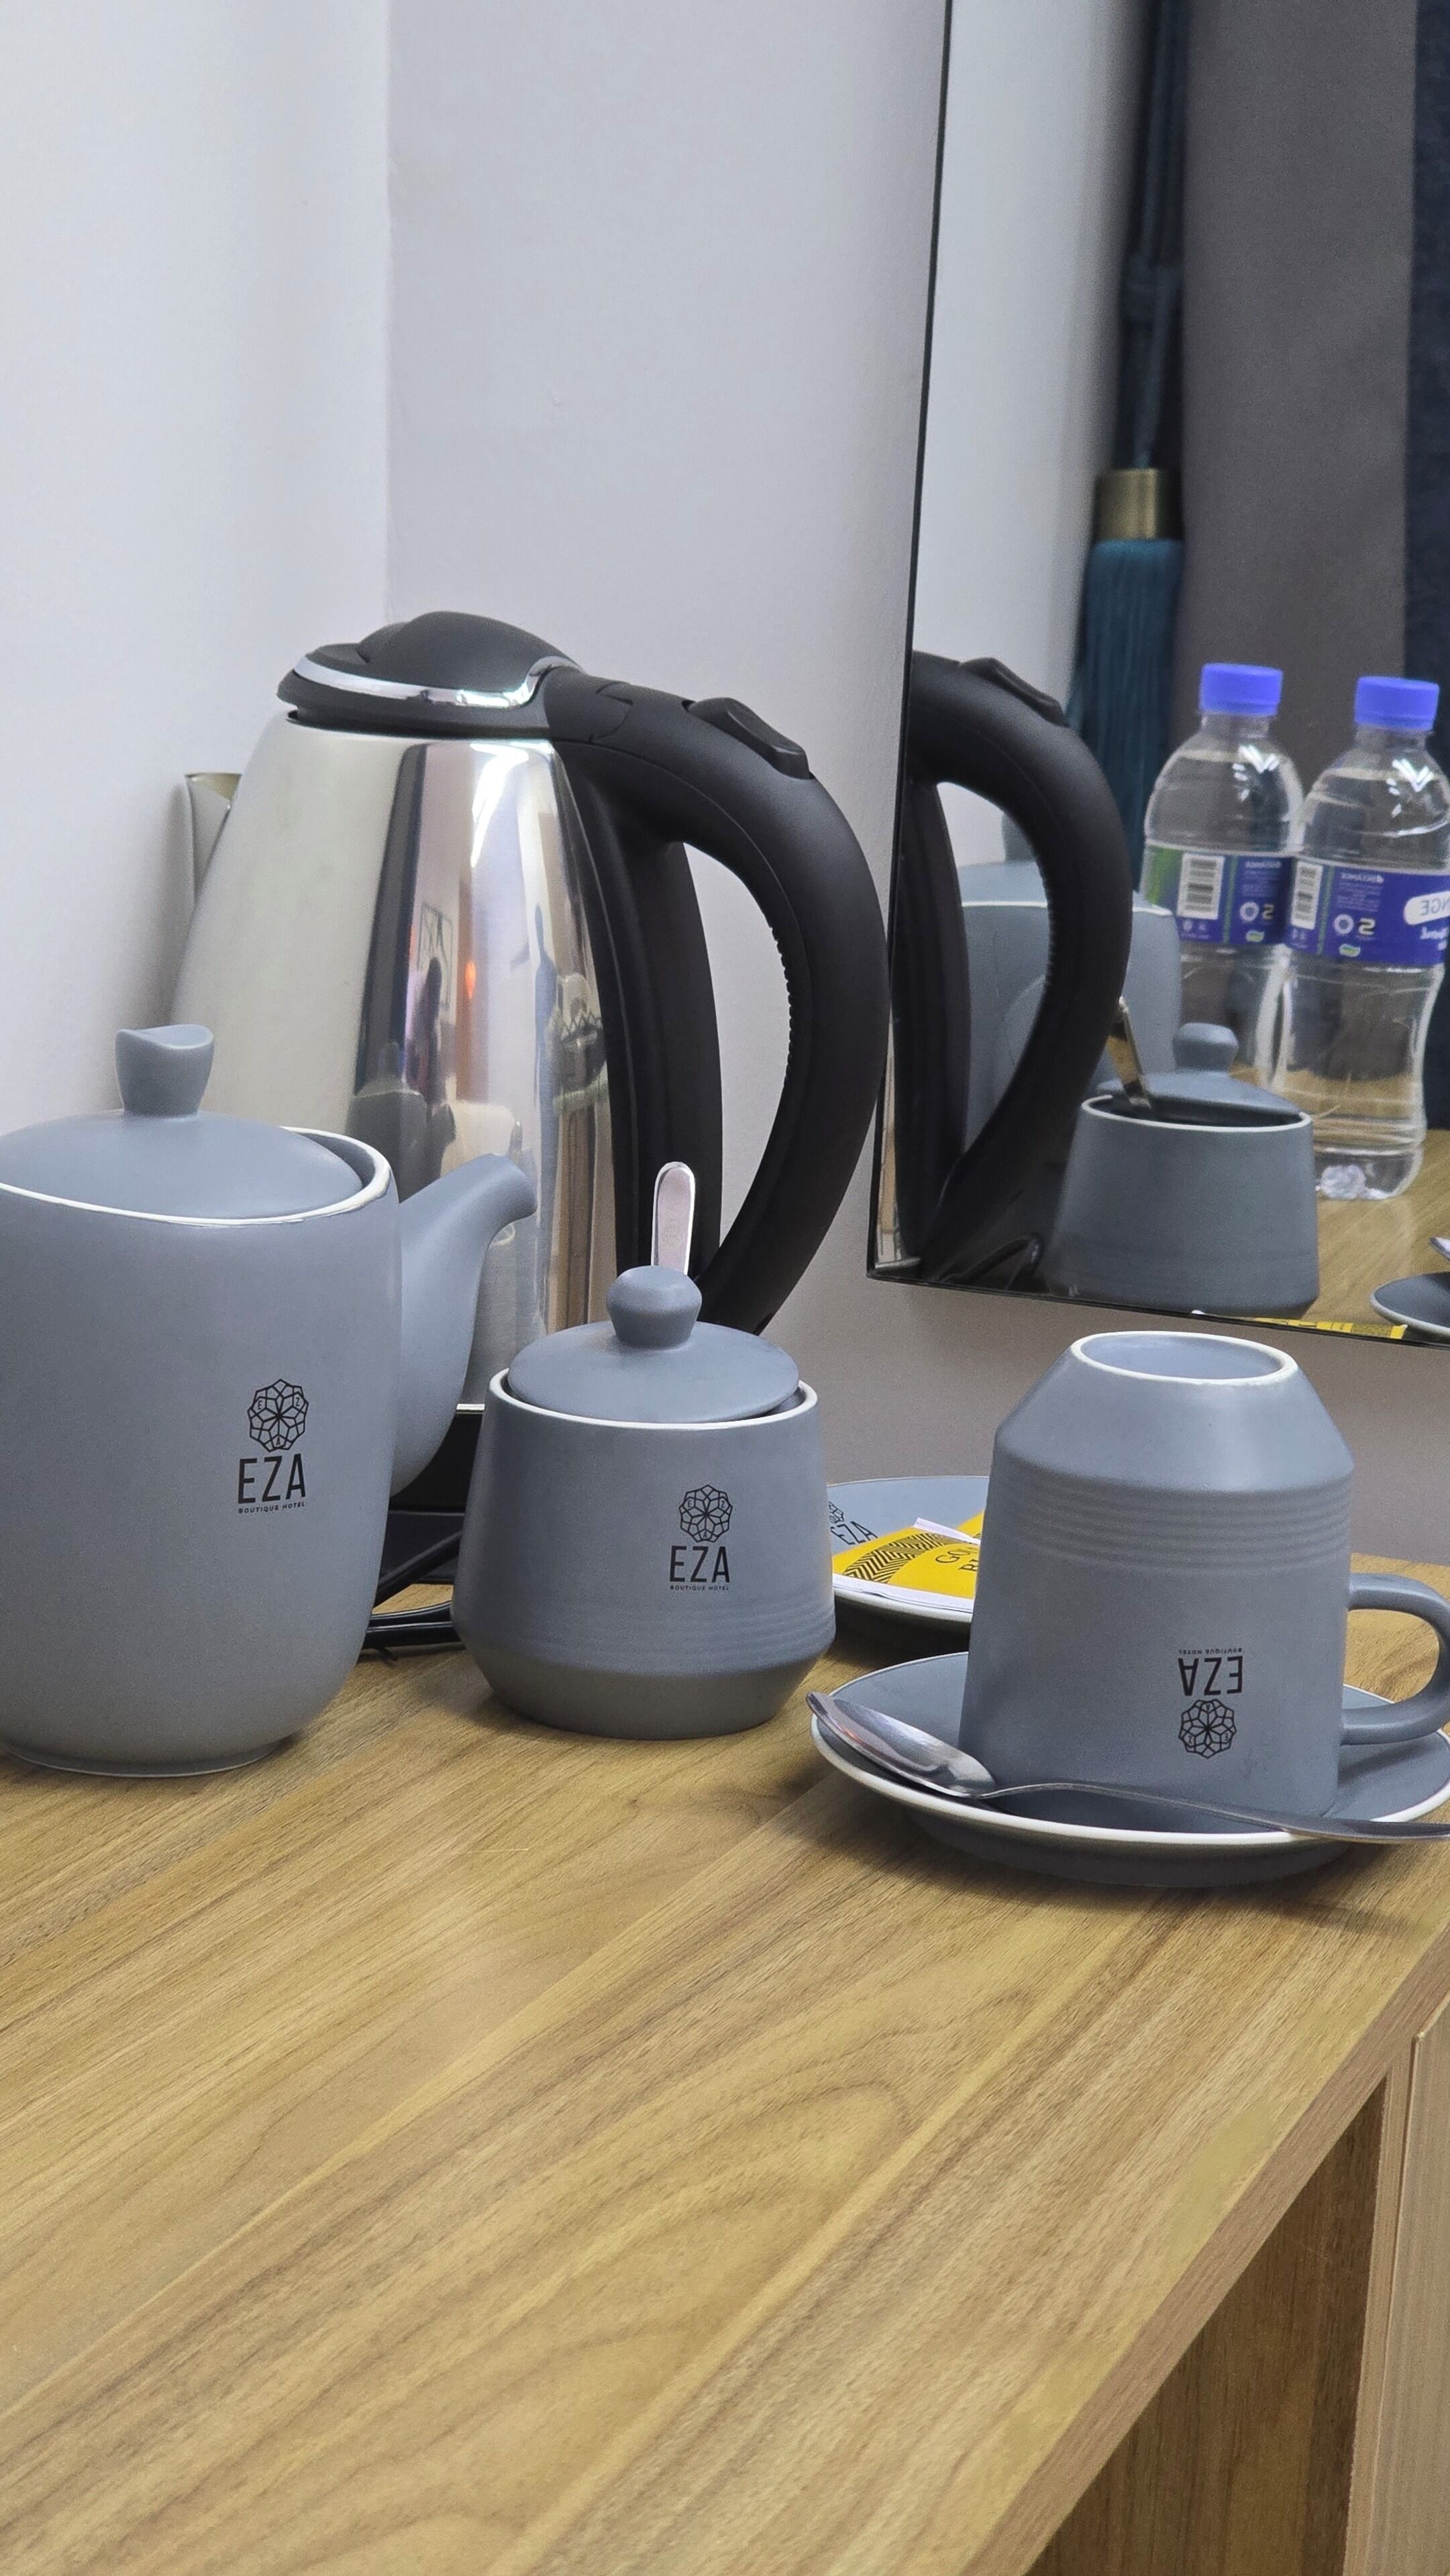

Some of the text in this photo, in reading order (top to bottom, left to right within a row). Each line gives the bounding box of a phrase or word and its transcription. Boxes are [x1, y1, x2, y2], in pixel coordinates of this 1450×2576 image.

[238, 1453, 306, 1504] EZA
[238, 1501, 305, 1514] BOUTIQUE HOTEL
[830, 1521, 878, 1545] EZA
[669, 1545, 730, 1583] EZA
[1178, 1656, 1243, 1697] EZA
